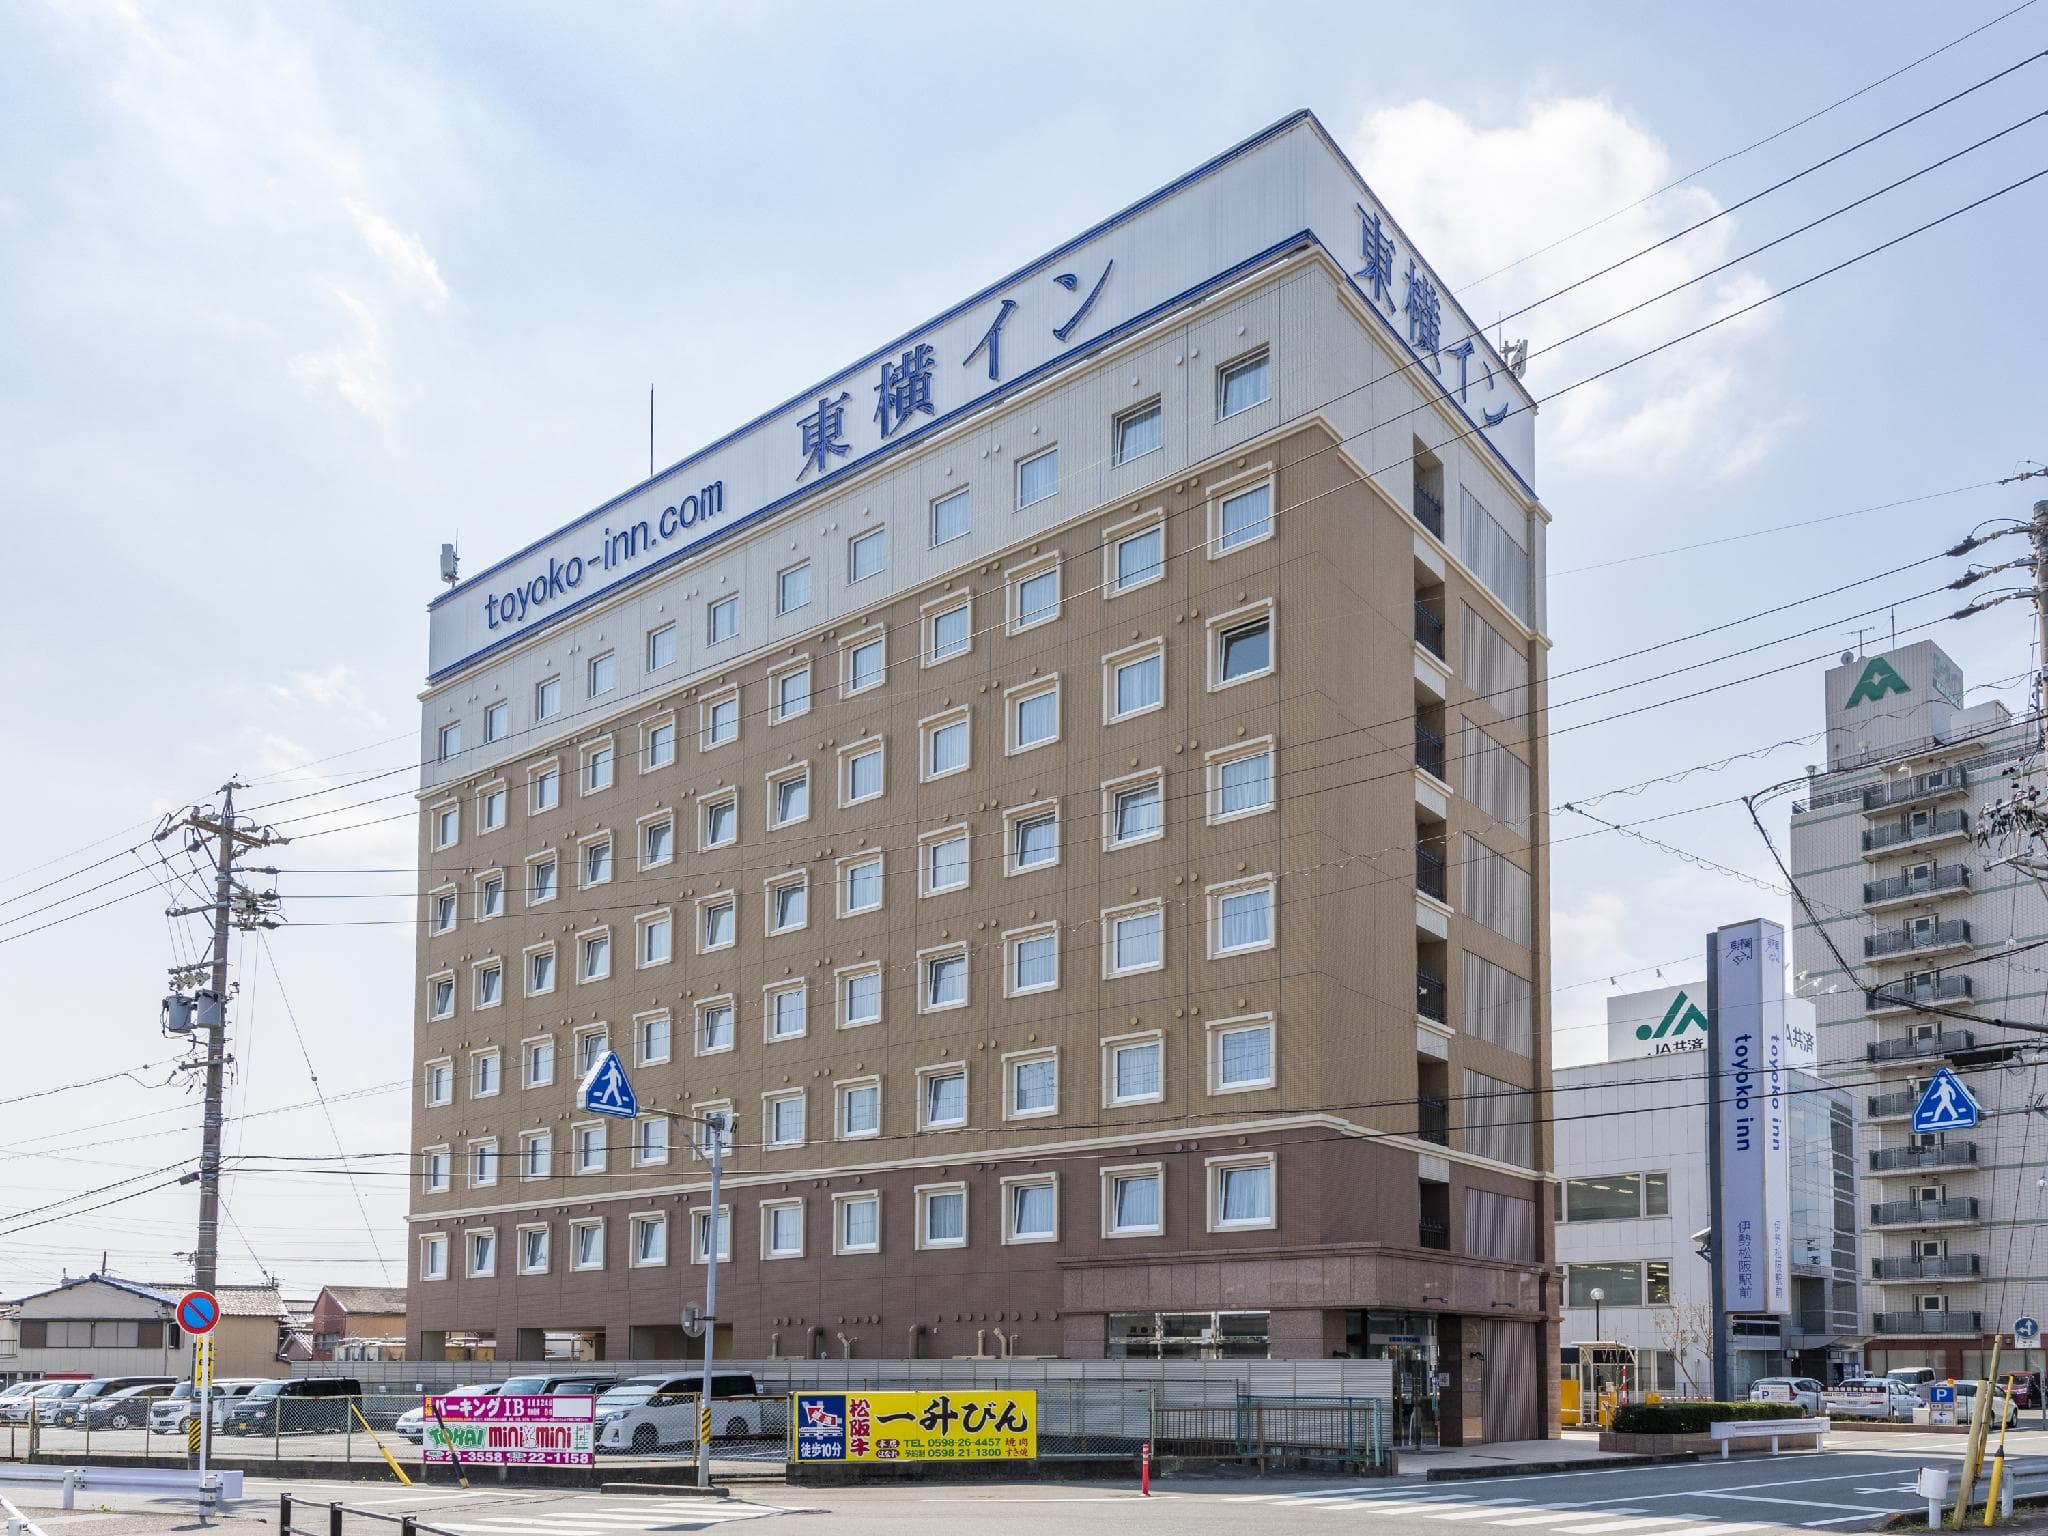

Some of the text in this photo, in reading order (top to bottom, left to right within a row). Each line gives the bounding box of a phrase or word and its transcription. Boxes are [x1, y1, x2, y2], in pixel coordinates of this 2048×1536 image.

[1353, 202, 1509, 427] 東横イン
[796, 258, 1114, 482] 東横イン
[485, 481, 723, 629] toyoko-inn.com
[1732, 1034, 1754, 1151] toyoko inn
[1769, 1034, 1781, 1151] toyoko inn
[1737, 1220, 1753, 1299] 伊勢松阪駅前
[876, 1395, 1028, 1437] 一升びん
[1936, 1389, 1948, 1401] P
[488, 1426, 523, 1448] mini
[536, 1426, 571, 1449] mini
[801, 1441, 842, 1458] 徒歩10分
[849, 1398, 871, 1457] 松阪牛
[904, 1440, 924, 1448] TEL
[928, 1438, 1001, 1447] 0598-26-4457
[528, 1453, 589, 1464] 22-1158
[928, 1449, 1001, 1458] 0598-21-1300
